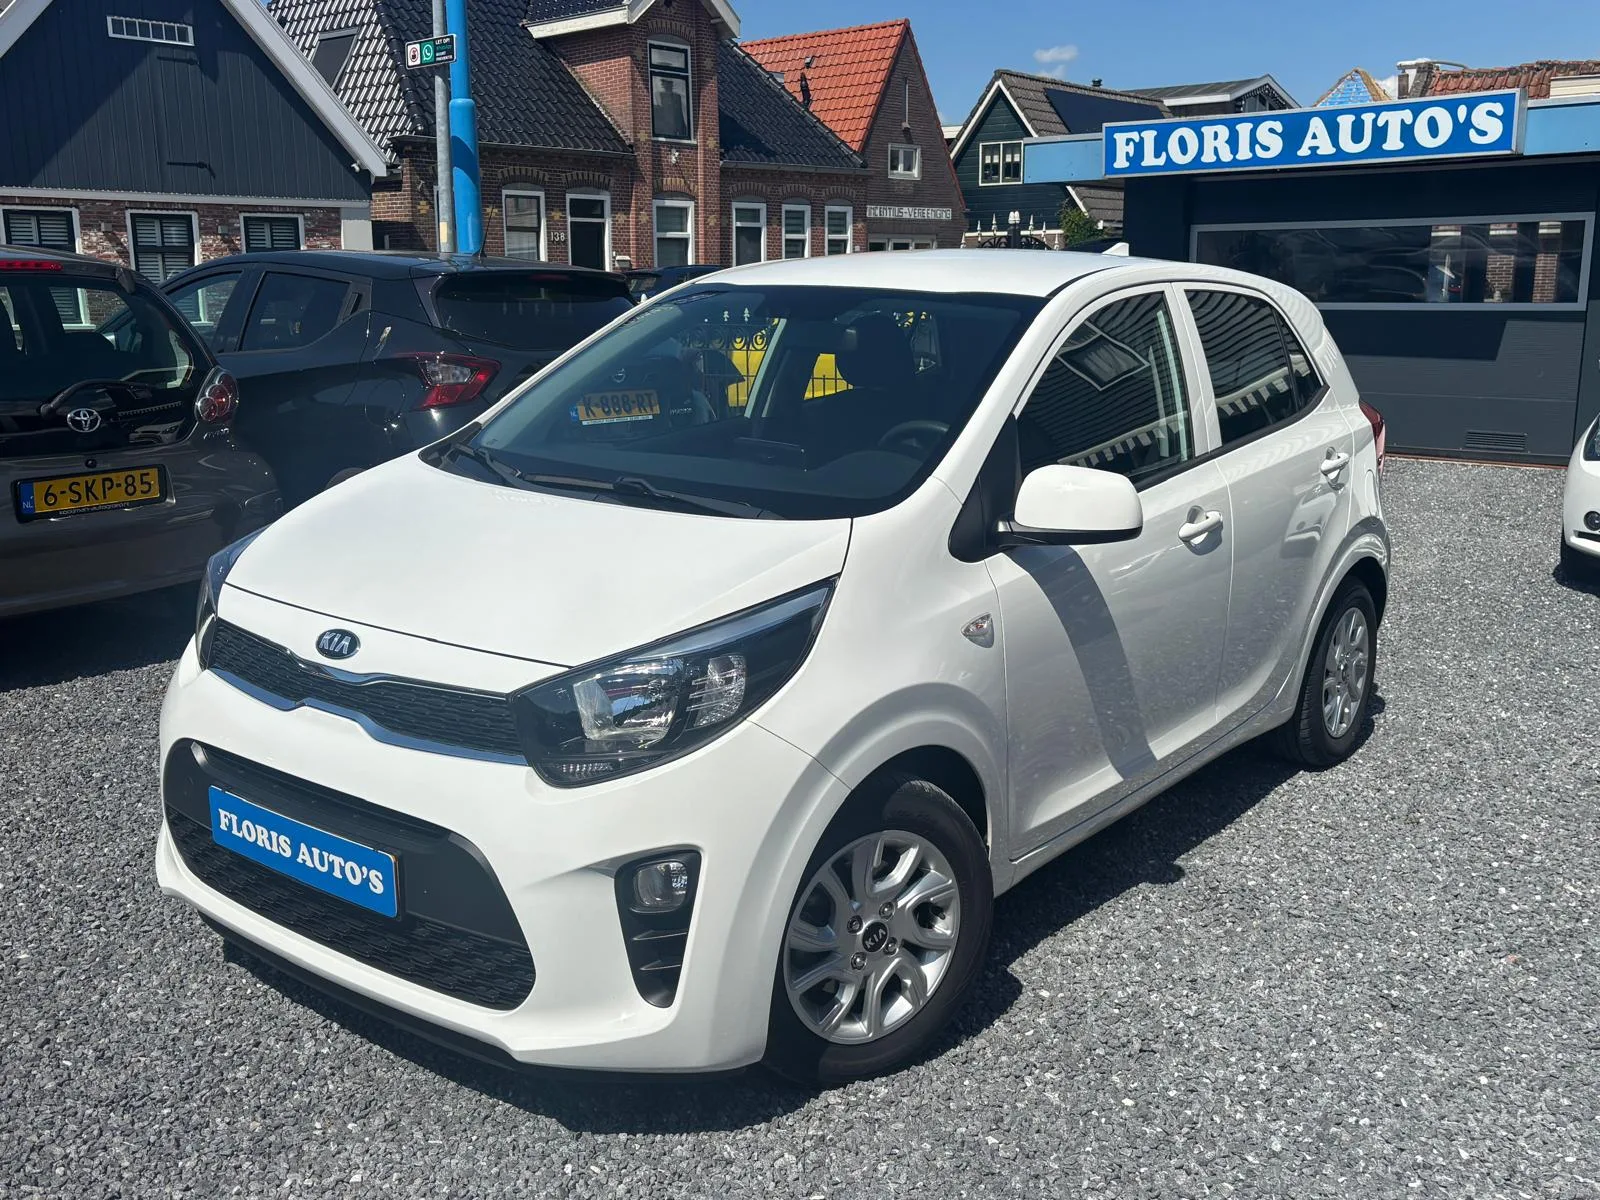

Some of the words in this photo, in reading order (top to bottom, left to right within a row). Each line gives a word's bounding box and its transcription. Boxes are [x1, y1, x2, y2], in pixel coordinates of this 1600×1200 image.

[1113, 121, 1283, 168] FLORIS
[1297, 102, 1504, 156] AUTO'S
[551, 231, 566, 242] 138
[43, 472, 152, 506] 6-SKP-85
[22, 500, 34, 509] NL
[318, 631, 352, 655] KIA
[217, 808, 292, 858] FLORIS
[296, 842, 385, 894] AUTO'S
[864, 928, 887, 949] KIA
